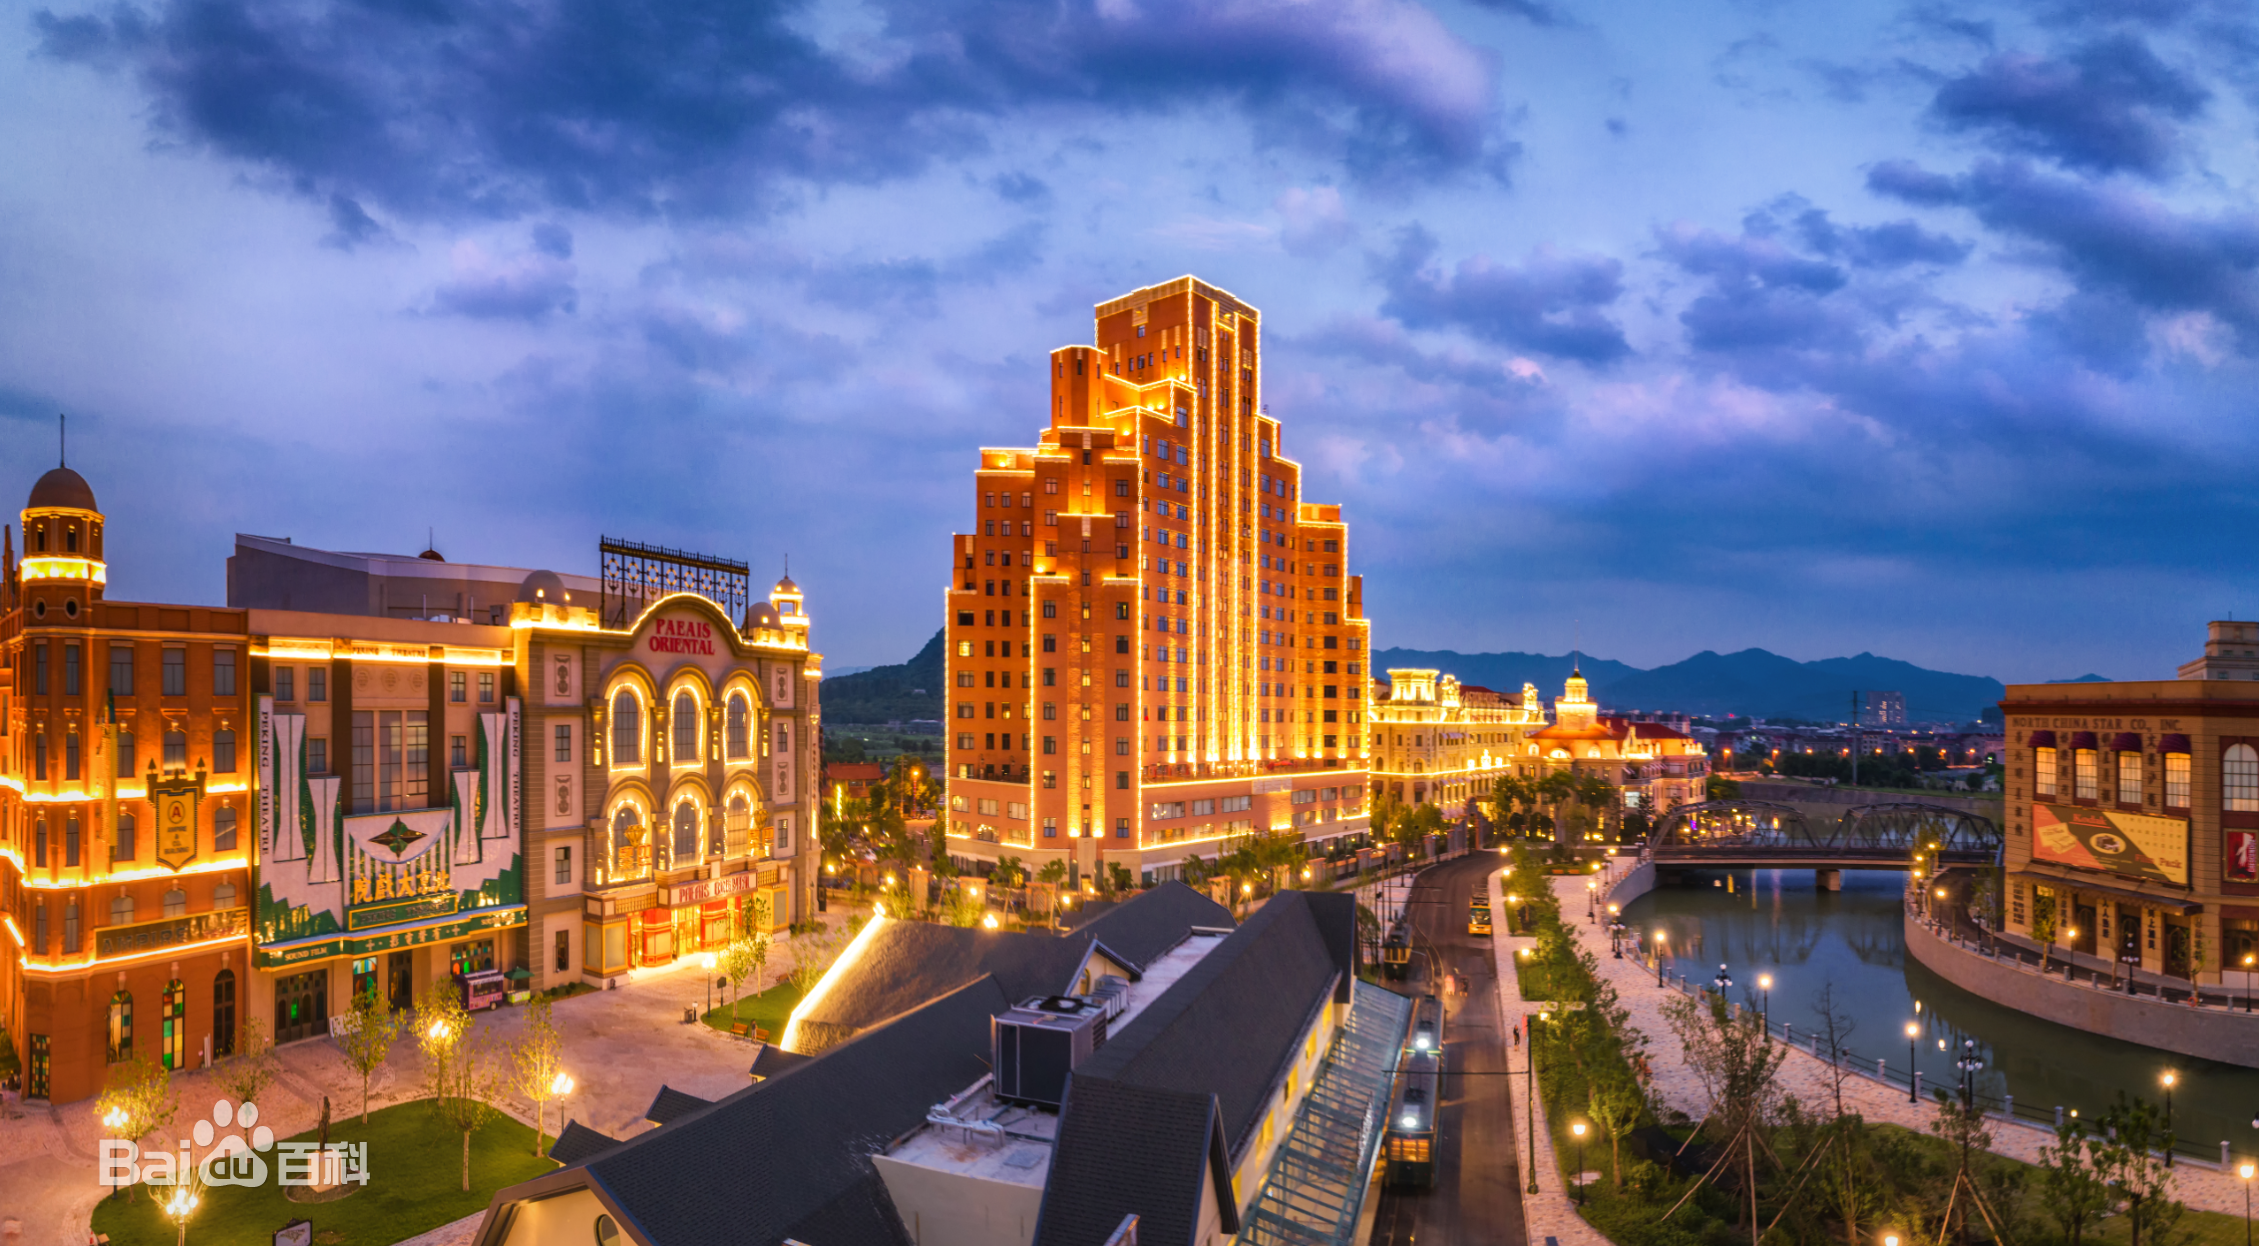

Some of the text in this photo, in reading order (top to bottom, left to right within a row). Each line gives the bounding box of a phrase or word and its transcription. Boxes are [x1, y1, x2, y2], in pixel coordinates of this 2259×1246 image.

[649, 635, 716, 656] ORIENTAL
[2012, 717, 2048, 728] NORTH
[2052, 717, 2089, 729] CHINA
[2092, 717, 2123, 730] STAR
[2159, 718, 2183, 731] INC.
[261, 711, 269, 856] PEKING THEATRE
[512, 771, 520, 830] THEATRE
[171, 806, 182, 817] A
[2072, 813, 2107, 826] Kodak
[2159, 857, 2182, 868] Pack
[102, 925, 189, 957] AMPIRE
[285, 946, 327, 962] SOUND FILM
